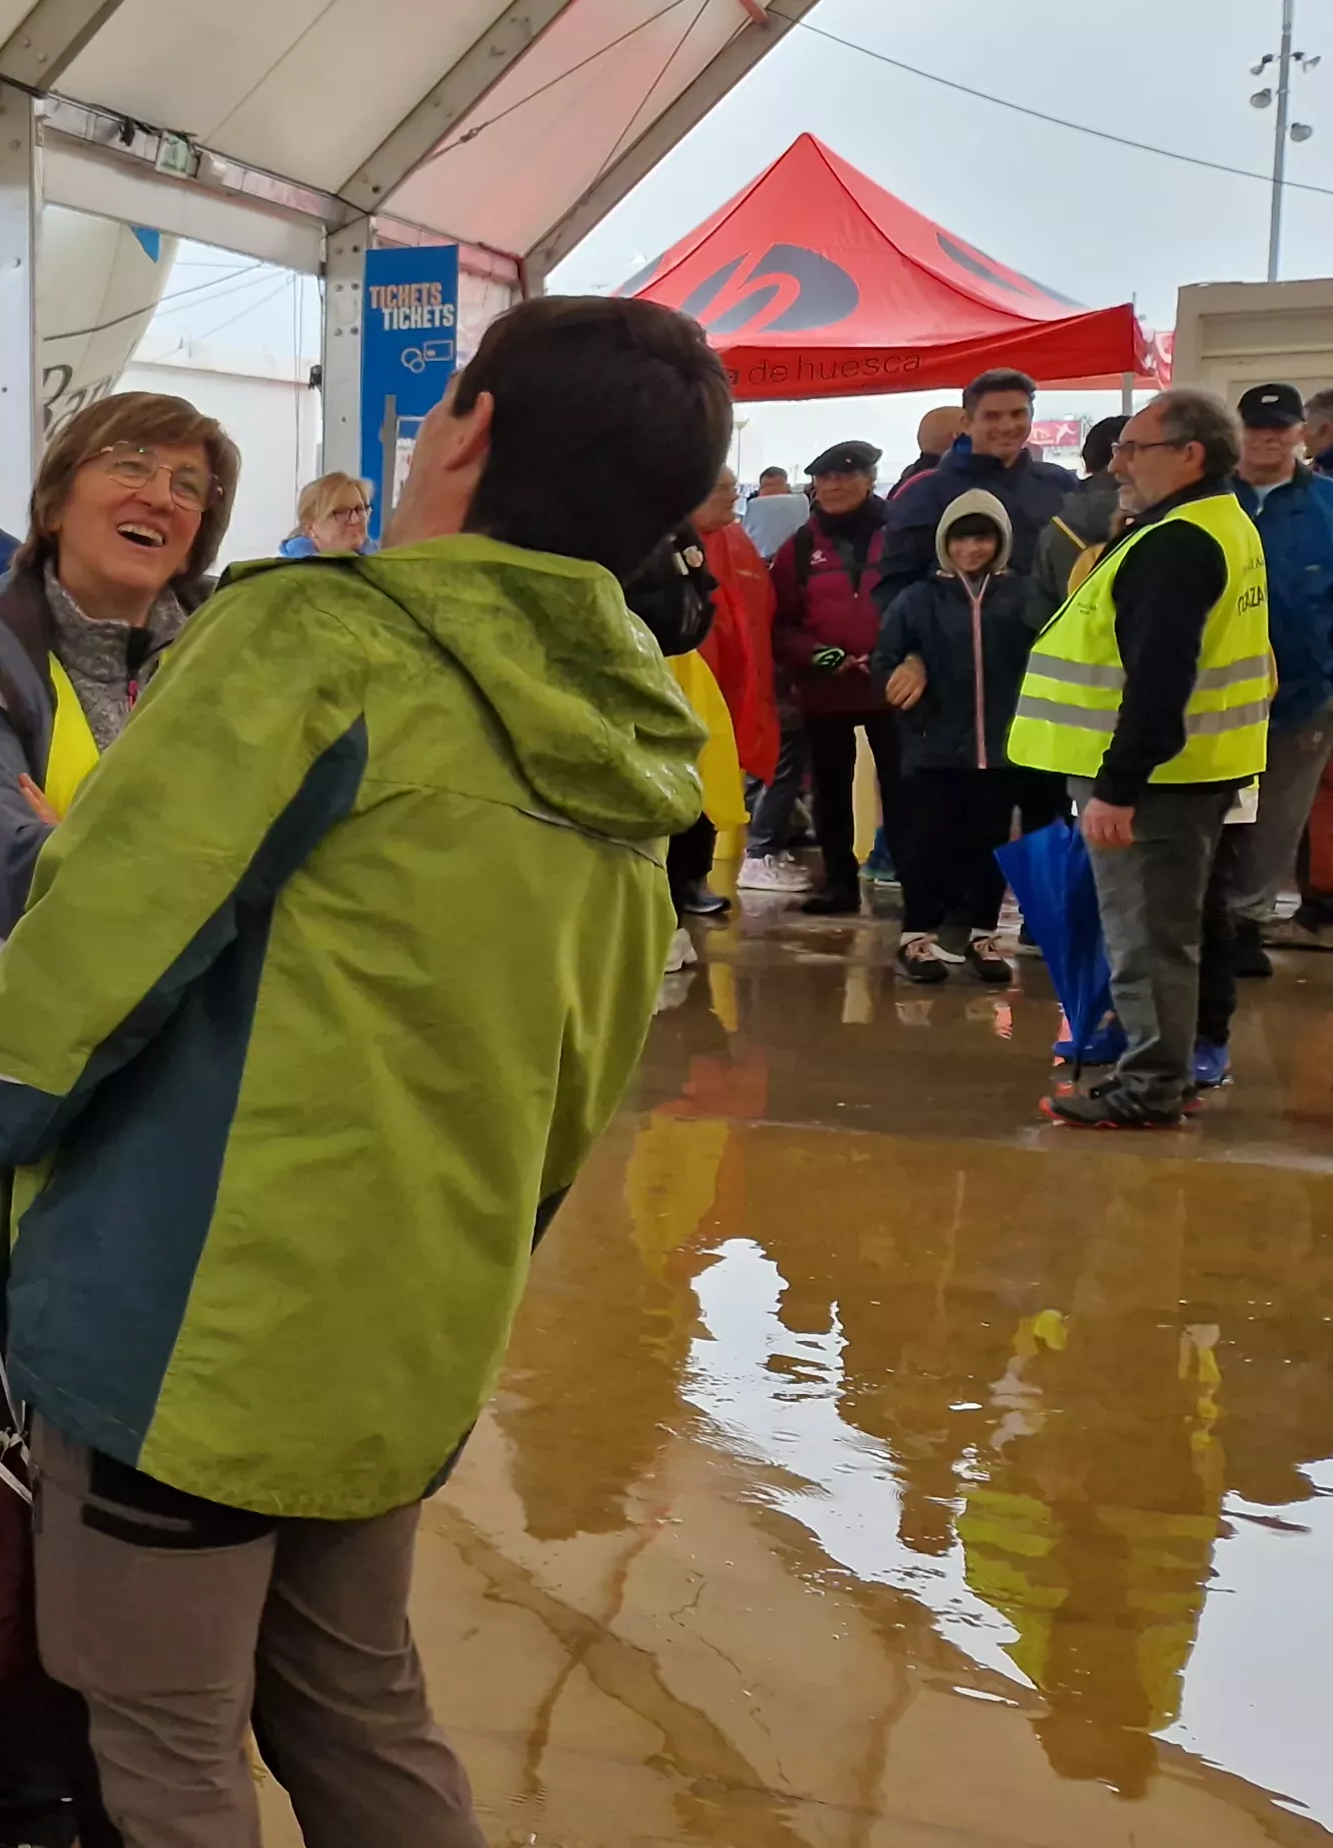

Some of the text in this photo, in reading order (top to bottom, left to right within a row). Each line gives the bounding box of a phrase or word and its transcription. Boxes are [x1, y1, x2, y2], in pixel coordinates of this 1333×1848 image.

[369, 282, 442, 309] TICKETS
[382, 304, 455, 331] TICKETS
[748, 358, 788, 386] de
[797, 353, 922, 382] huesca
